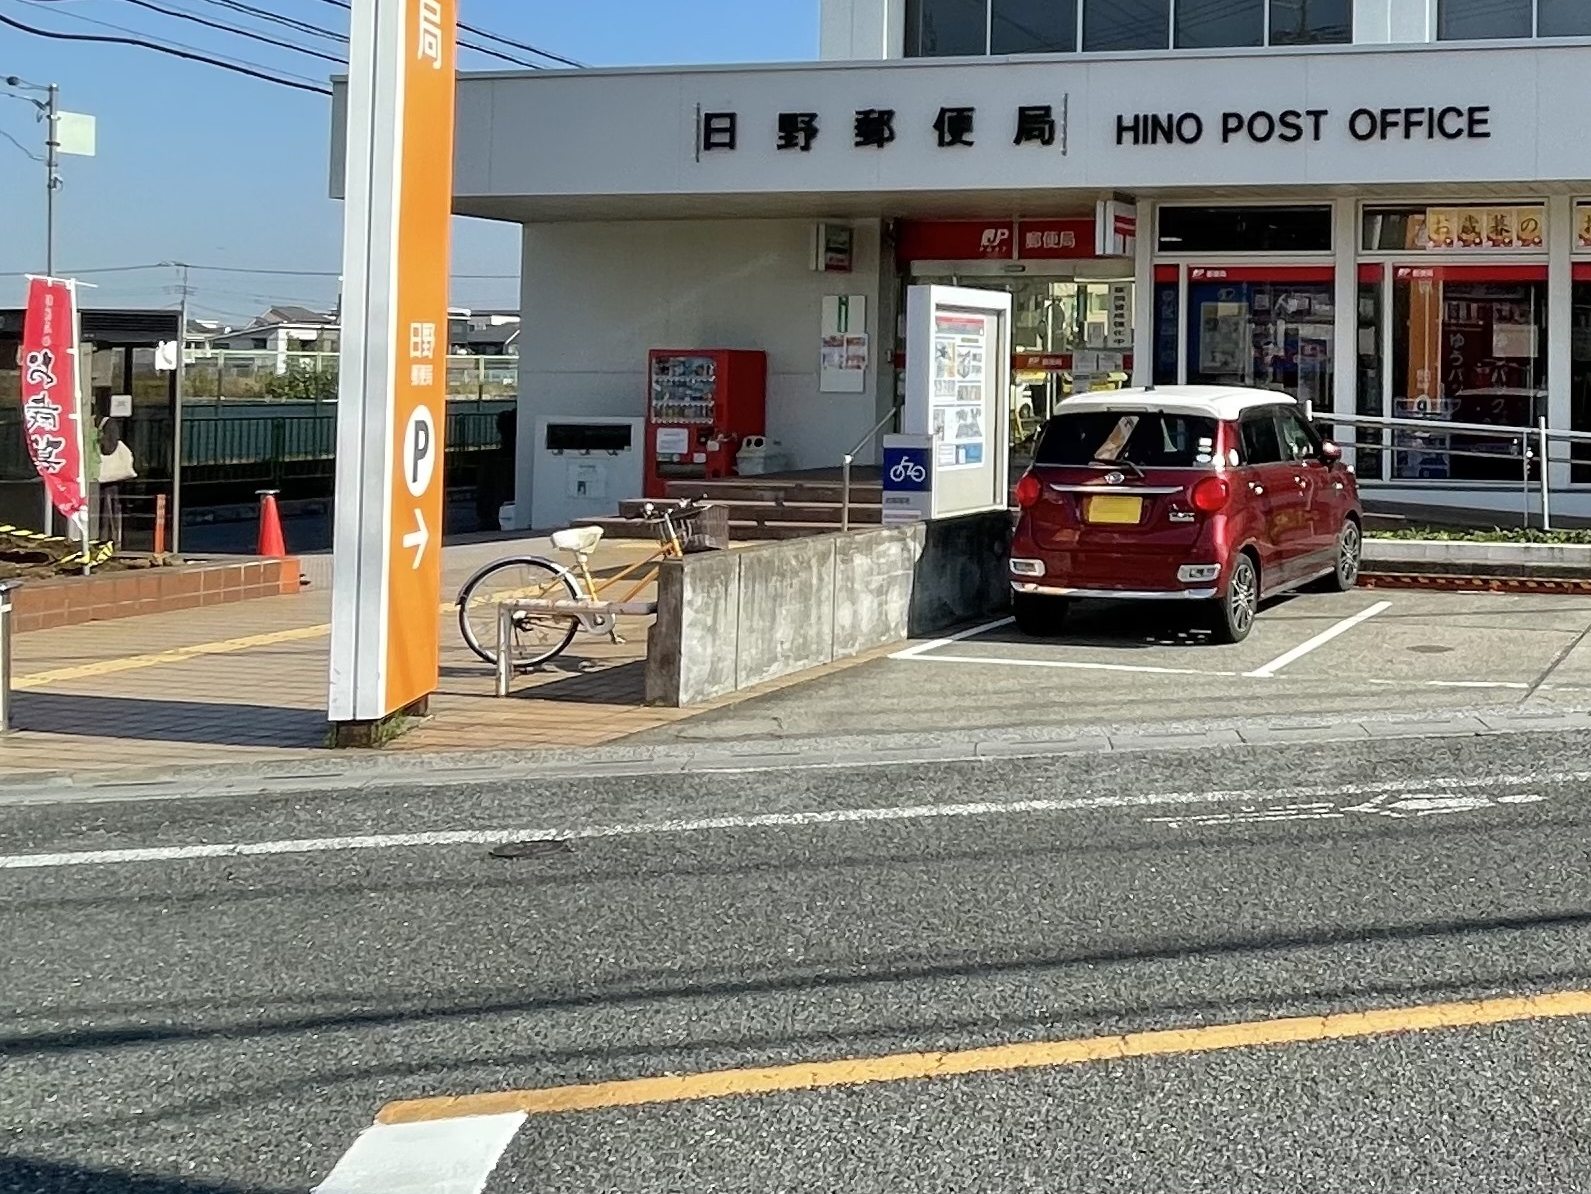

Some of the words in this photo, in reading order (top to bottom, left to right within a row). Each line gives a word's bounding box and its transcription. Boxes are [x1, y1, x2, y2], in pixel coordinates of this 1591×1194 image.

[703, 105, 1056, 151] 日野郵便局
[1116, 113, 1202, 145] HINO
[1222, 110, 1328, 143] POST
[1349, 106, 1491, 141] OFFICE
[1026, 231, 1075, 248] 郵便局
[410, 322, 436, 358] 日野
[412, 419, 430, 483] P
